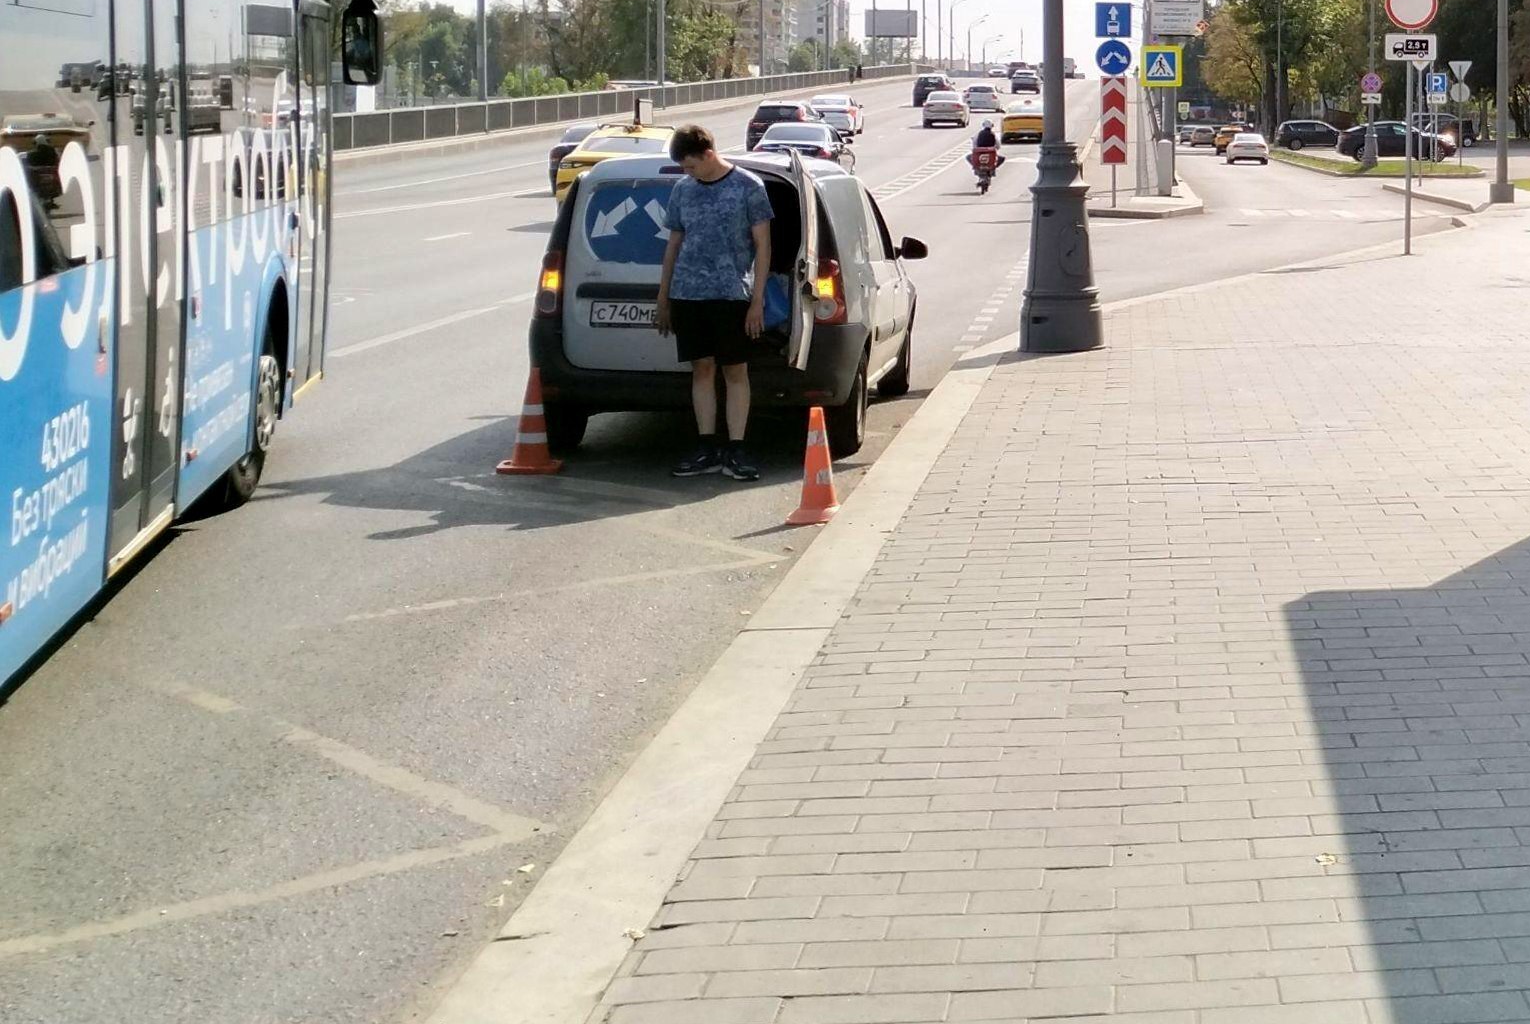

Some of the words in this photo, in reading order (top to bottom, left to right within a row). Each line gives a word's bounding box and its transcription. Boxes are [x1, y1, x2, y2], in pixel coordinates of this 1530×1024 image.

[41, 400, 89, 473] 430216
[11, 487, 40, 546] Без
[19, 507, 88, 609] вибраций
